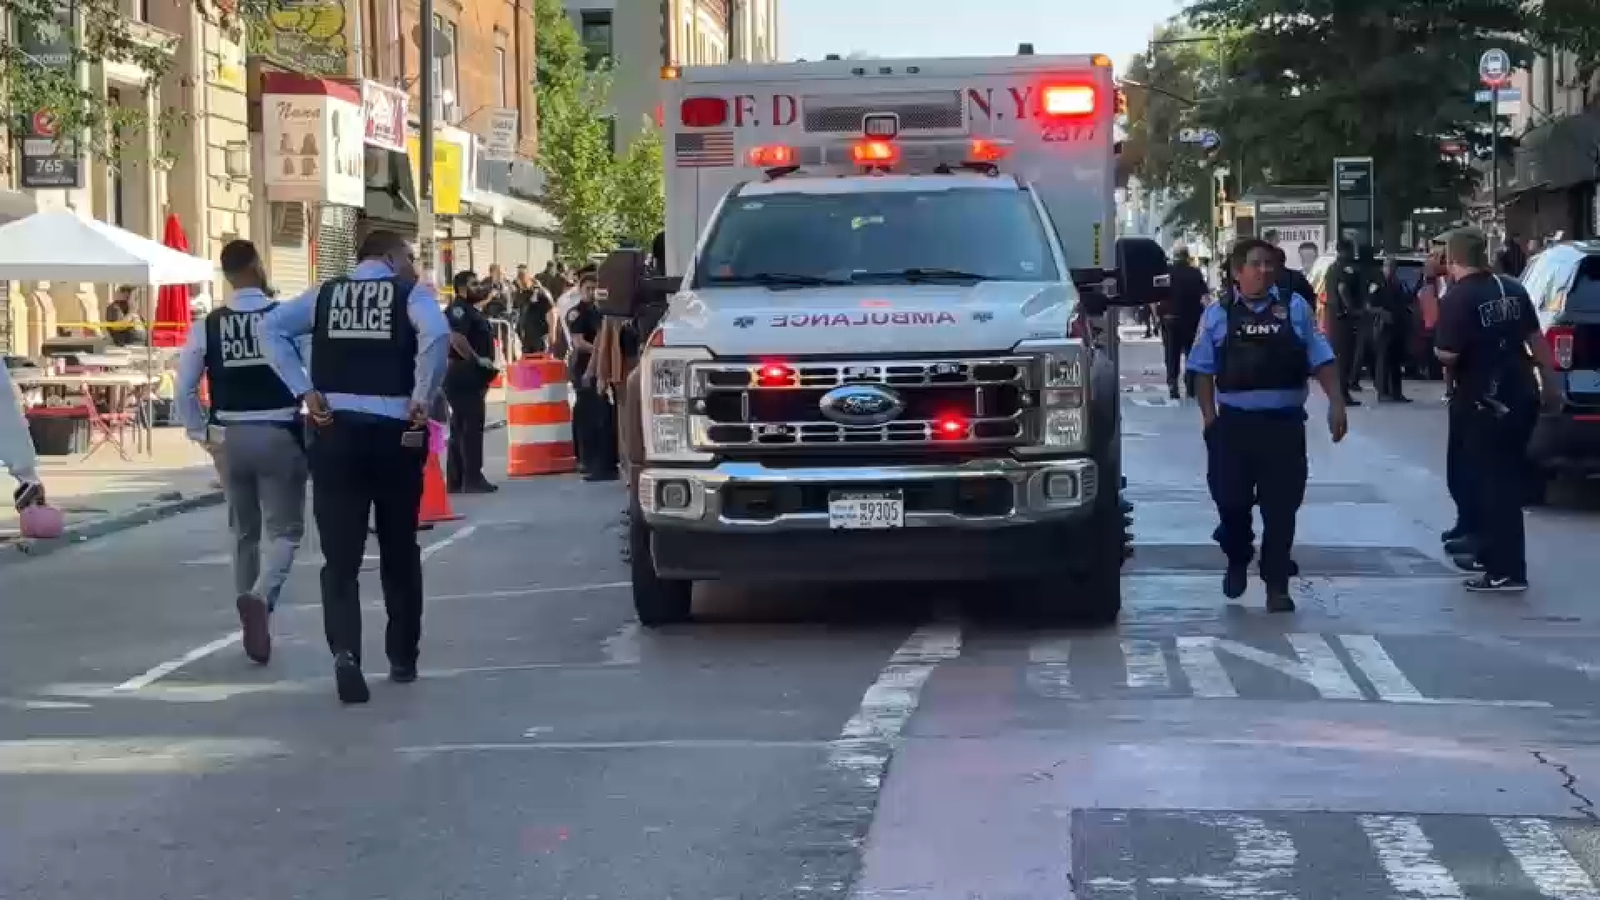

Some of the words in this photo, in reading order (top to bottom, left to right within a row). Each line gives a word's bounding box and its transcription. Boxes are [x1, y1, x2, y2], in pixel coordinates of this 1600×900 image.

[36, 160, 63, 173] 765
[331, 281, 394, 307] NYPD
[219, 312, 264, 339] NYP
[328, 307, 392, 330] POLICE
[221, 339, 262, 360] POLI
